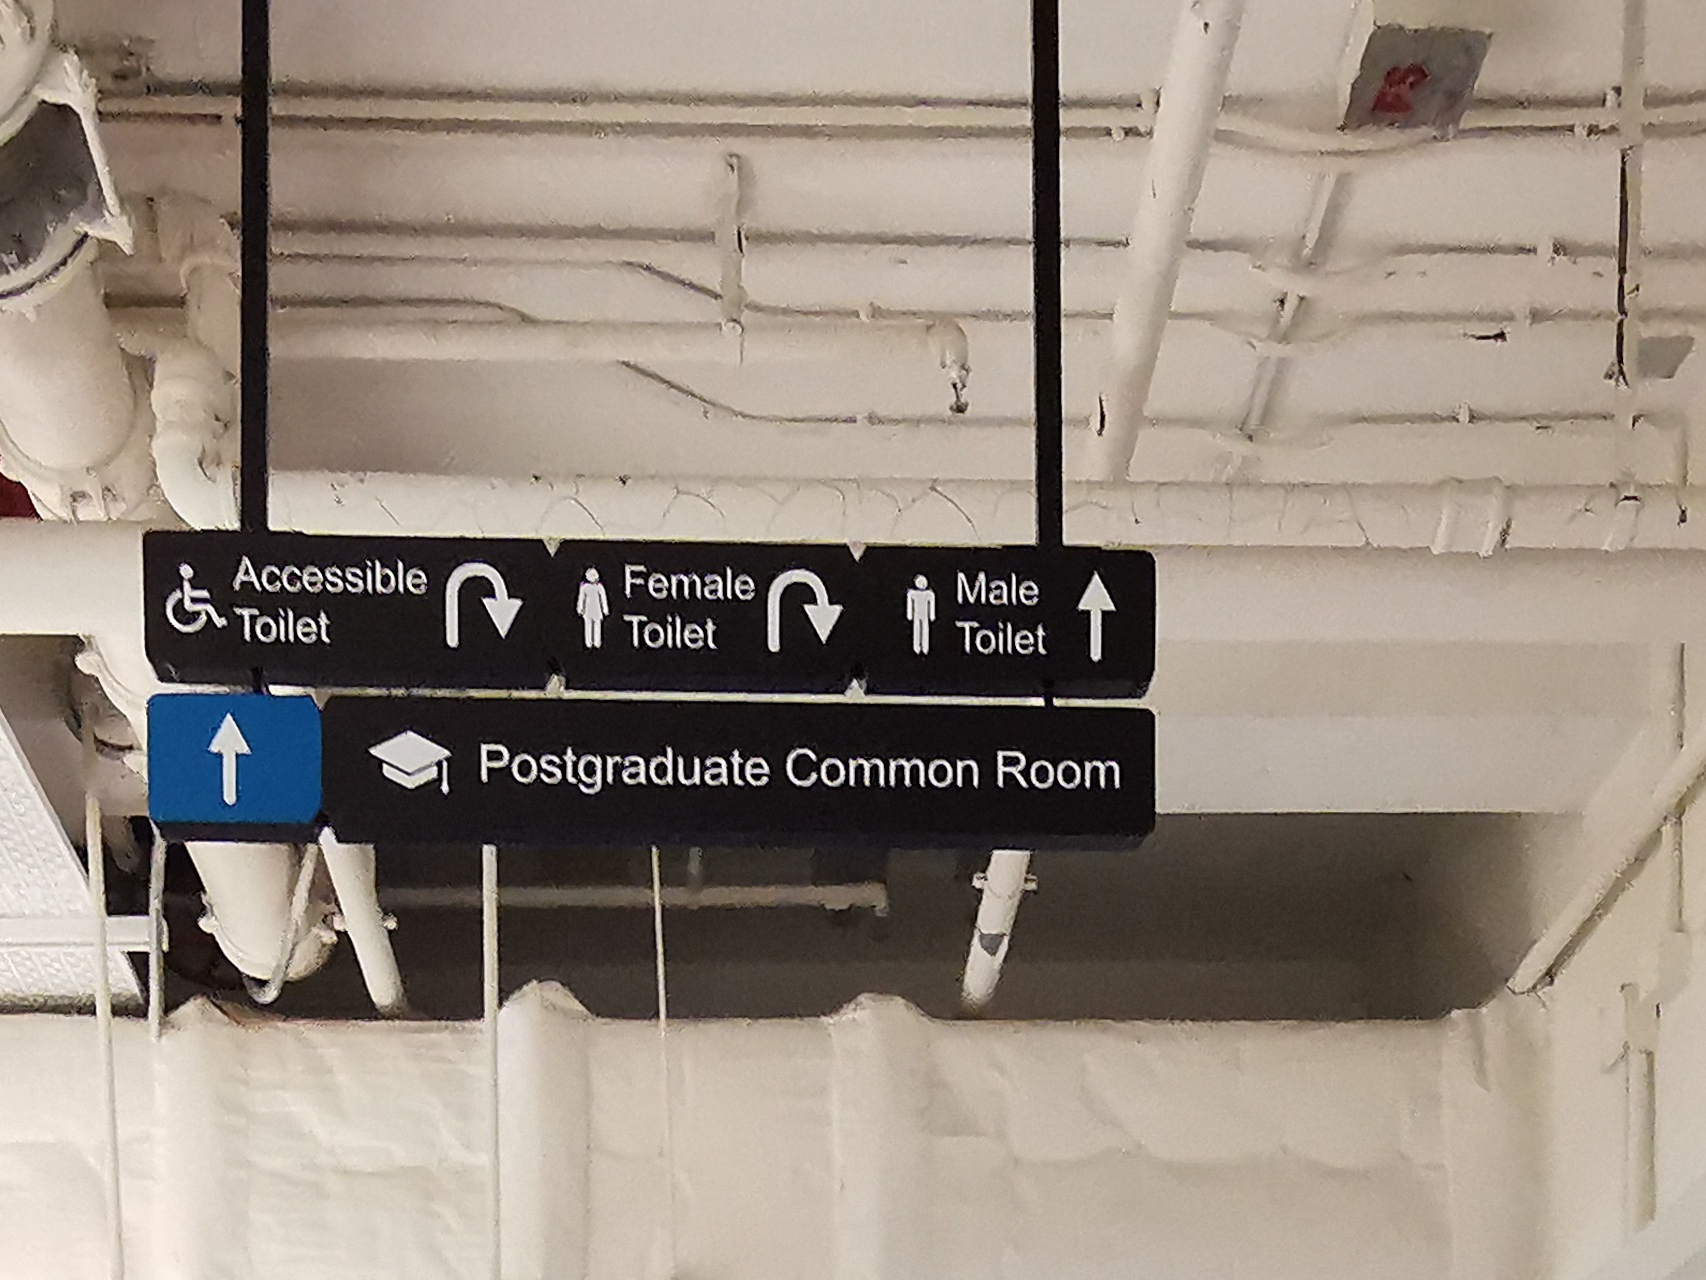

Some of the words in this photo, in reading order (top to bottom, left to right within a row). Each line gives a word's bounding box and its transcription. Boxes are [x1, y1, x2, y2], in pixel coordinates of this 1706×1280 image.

[231, 554, 429, 596] Accessible
[623, 563, 757, 602] Female
[956, 570, 1040, 607] Male
[232, 606, 332, 645] Toilet
[622, 613, 719, 651] Toilet
[953, 619, 1048, 656] Toilet
[479, 741, 771, 796] Postgraduate
[784, 746, 980, 790] Common
[995, 749, 1122, 790] Room
